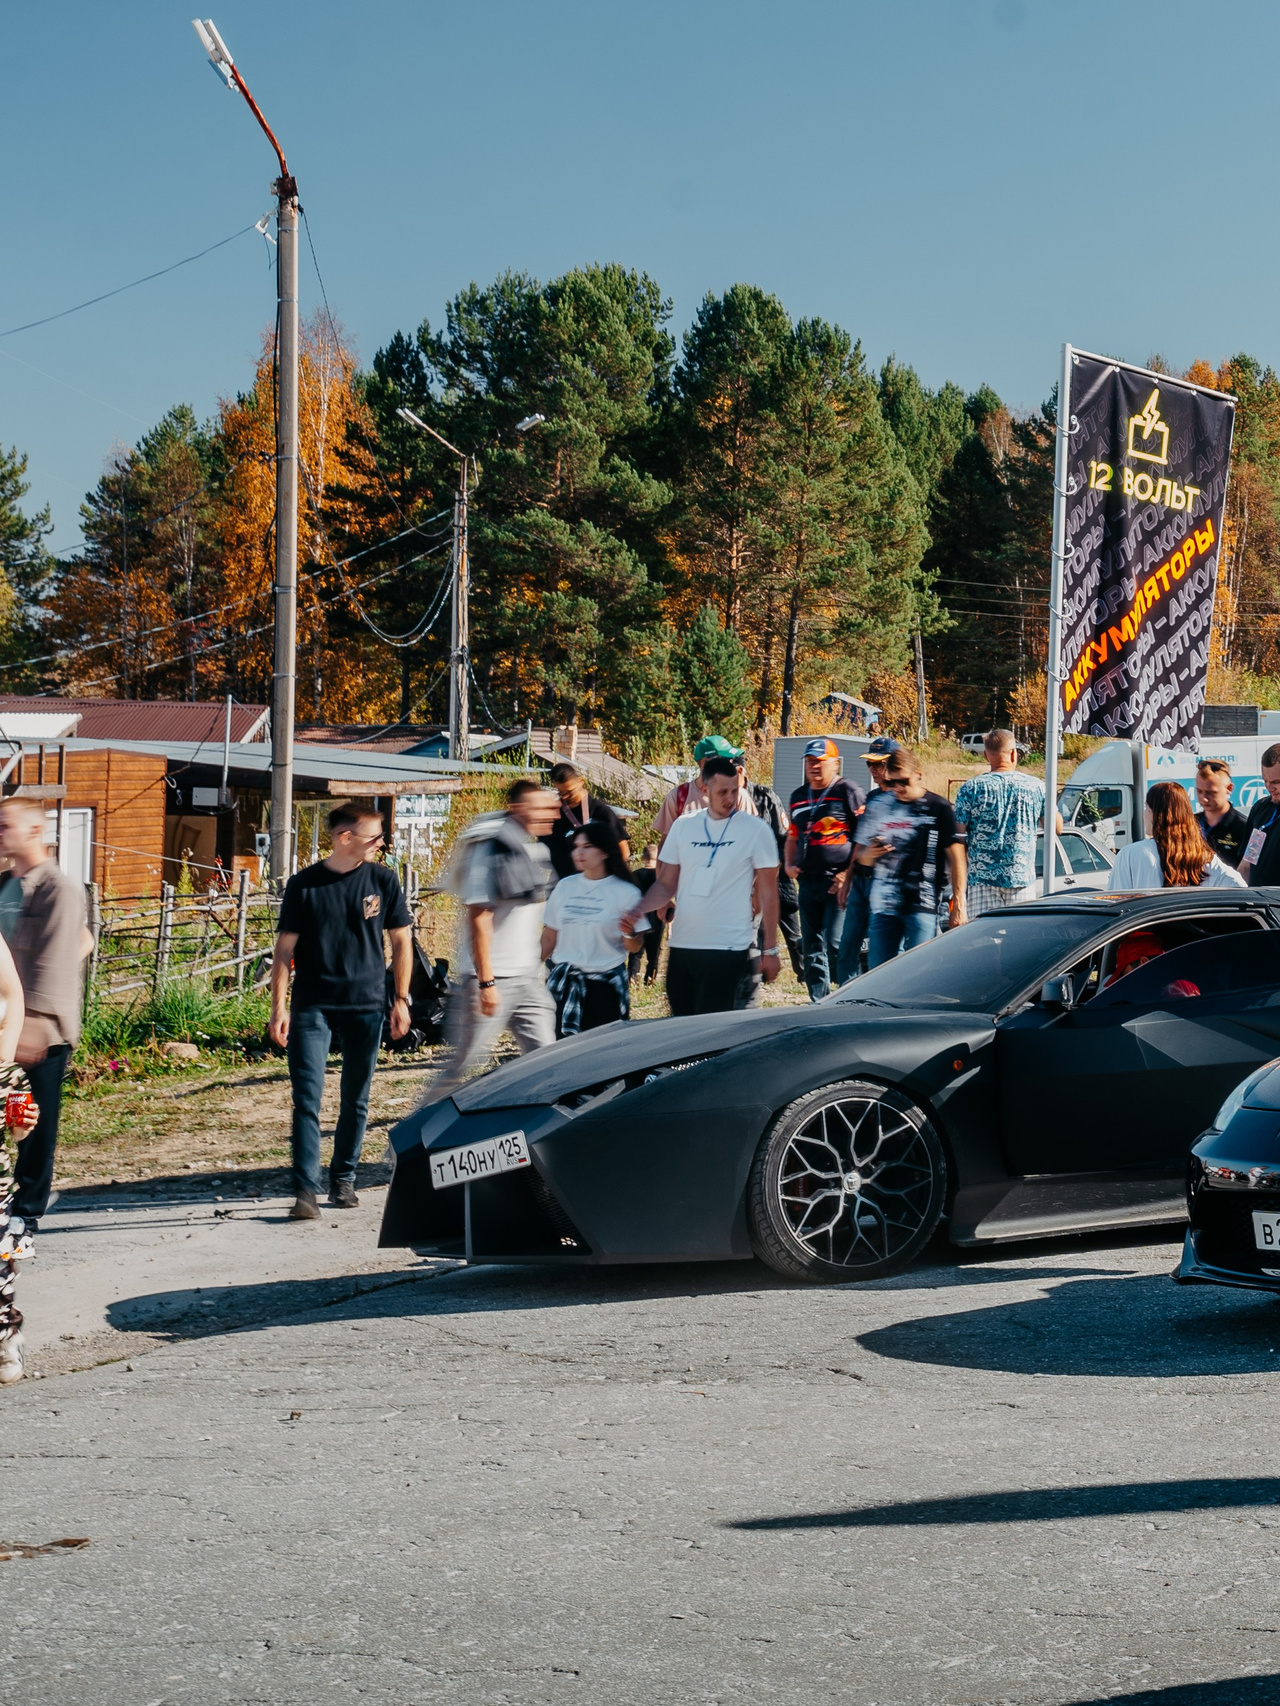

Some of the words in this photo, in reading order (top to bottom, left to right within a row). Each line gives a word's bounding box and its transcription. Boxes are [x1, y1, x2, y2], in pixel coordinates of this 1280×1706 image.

[1089, 460, 1113, 491] 12
[1123, 467, 1200, 514] ВОЛЬТ
[1064, 517, 1216, 712] АККУМУЛЯТОРЫ
[498, 1136, 521, 1157] 125
